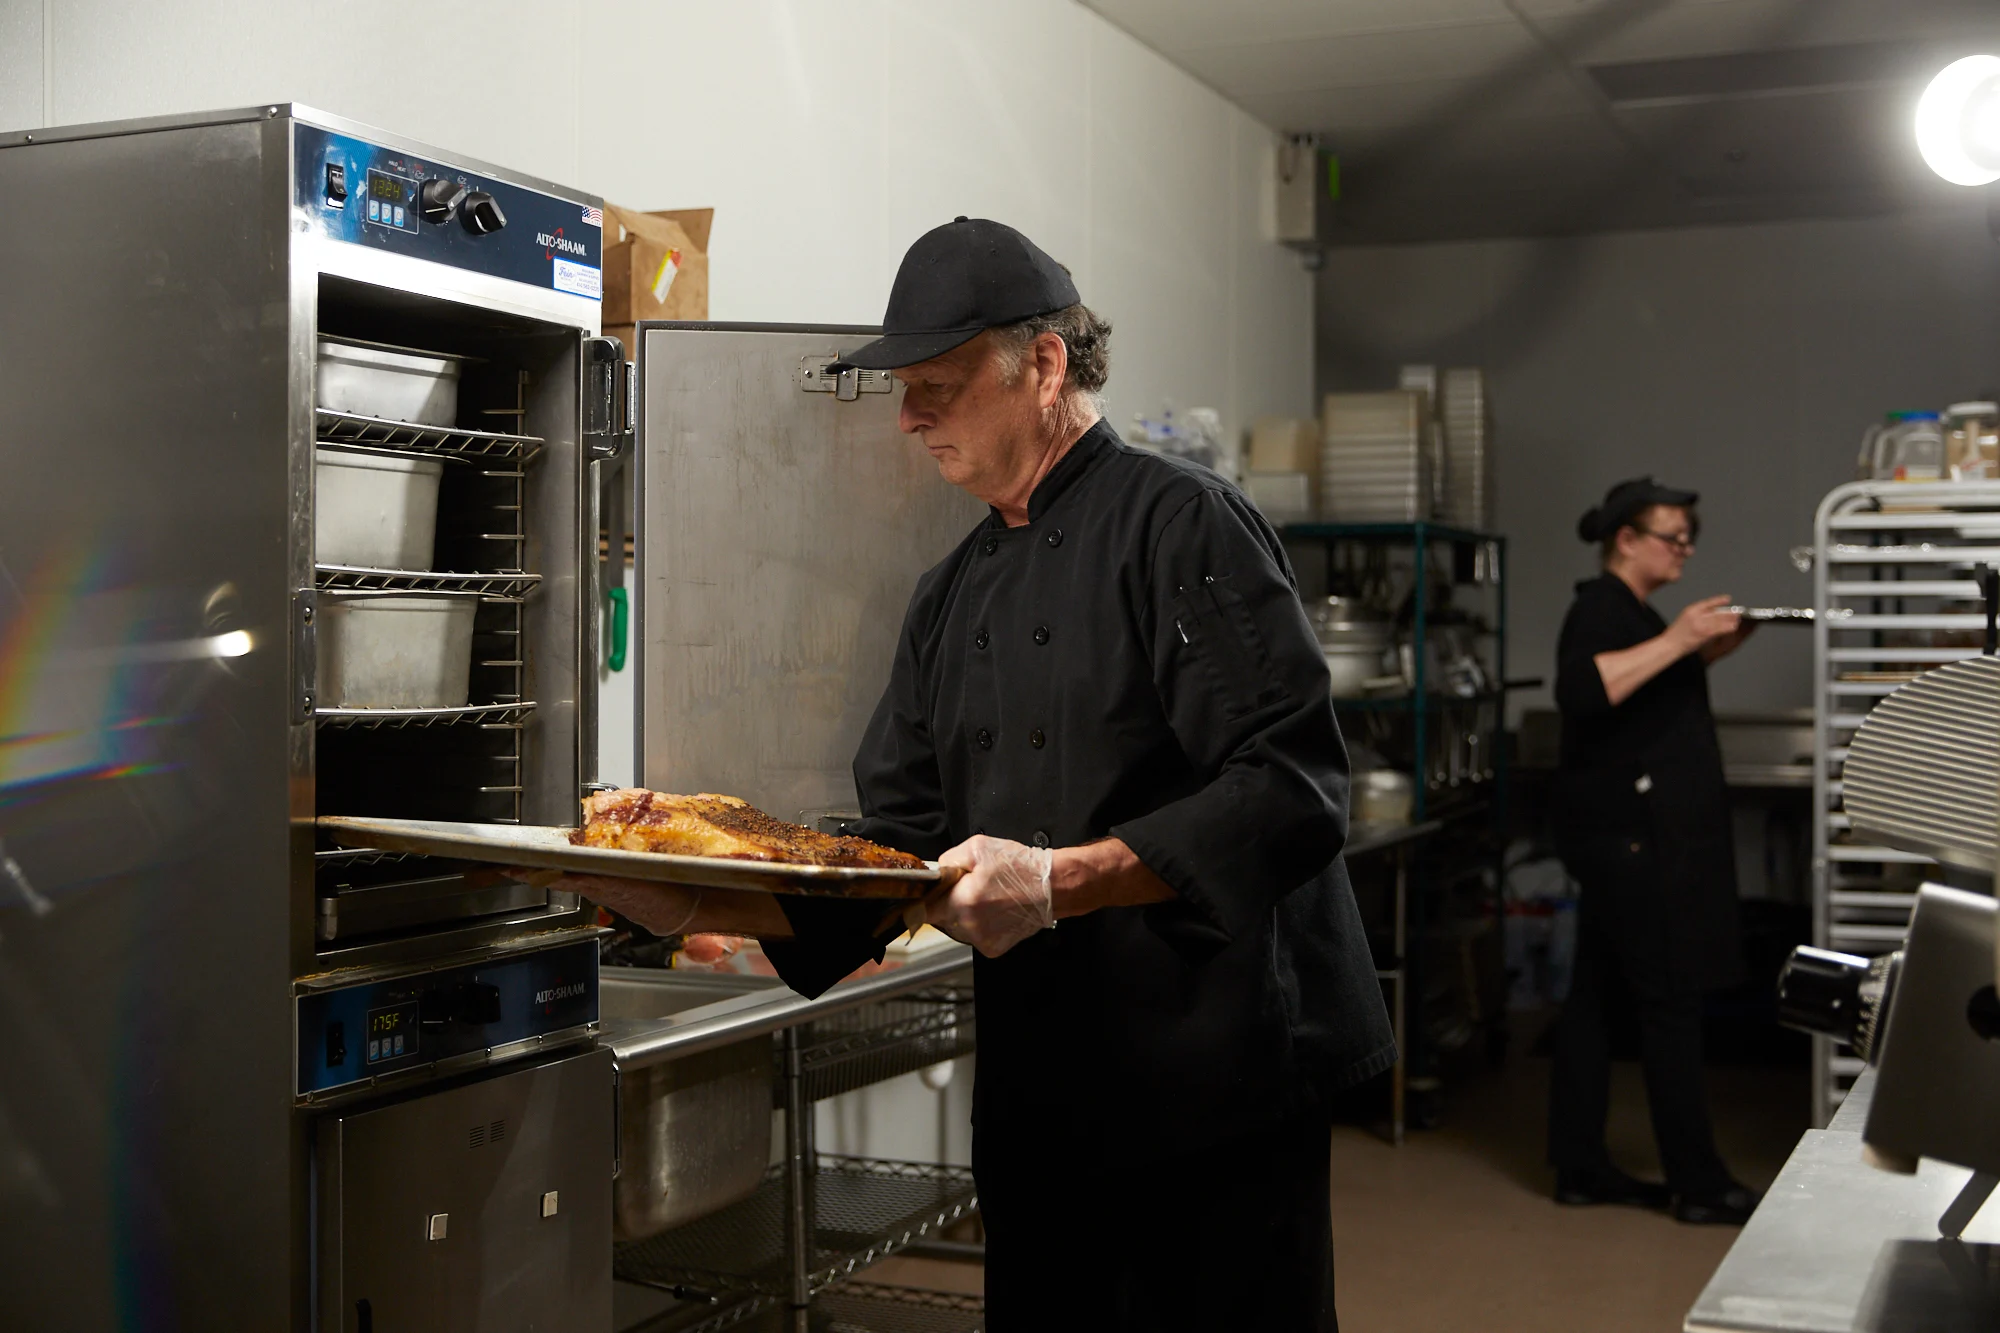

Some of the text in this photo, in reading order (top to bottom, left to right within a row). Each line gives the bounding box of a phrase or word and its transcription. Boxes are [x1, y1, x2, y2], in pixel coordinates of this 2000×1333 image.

[535, 232, 586, 257] ALTO-SHAAM
[535, 982, 585, 1005] ALTO-SHAAM
[373, 1012, 400, 1032] 175F
